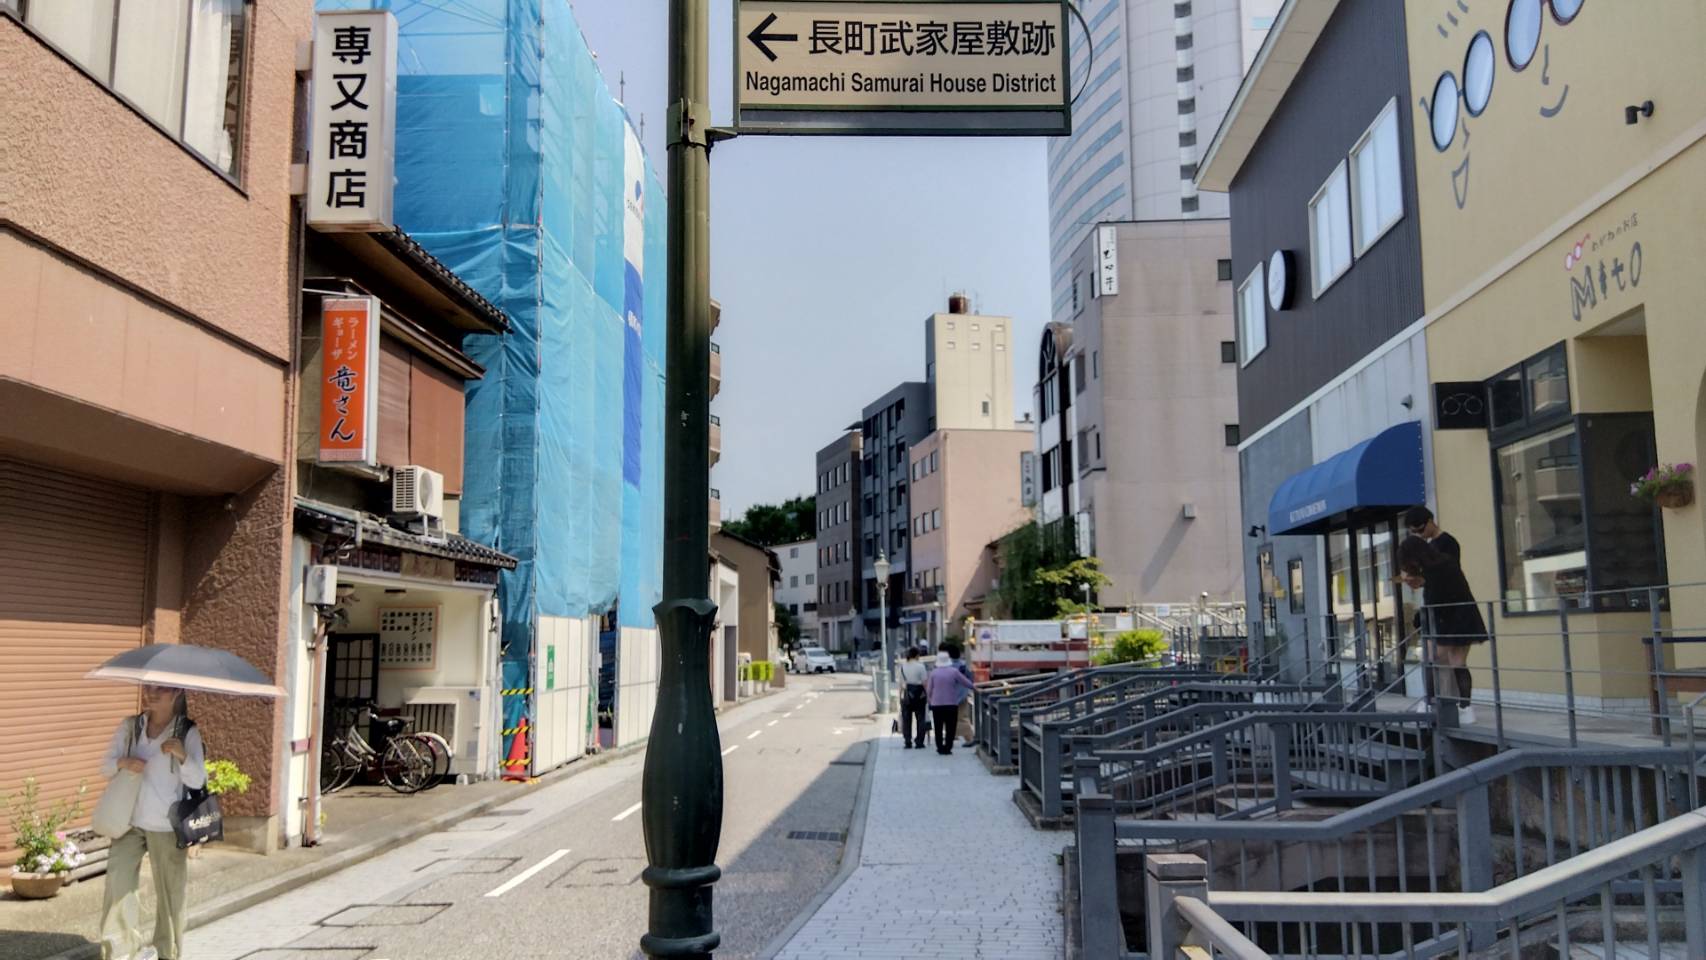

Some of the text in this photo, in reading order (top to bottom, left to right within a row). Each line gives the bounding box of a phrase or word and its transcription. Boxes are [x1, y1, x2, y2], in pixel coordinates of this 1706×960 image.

[808, 20, 1056, 56] 長町武家屋敷跡
[746, 71, 1056, 95] Nagamachi Samurai House District
[332, 317, 344, 360] ギョーザ
[348, 317, 359, 360] ラーメン
[329, 365, 358, 441] 竜さん
